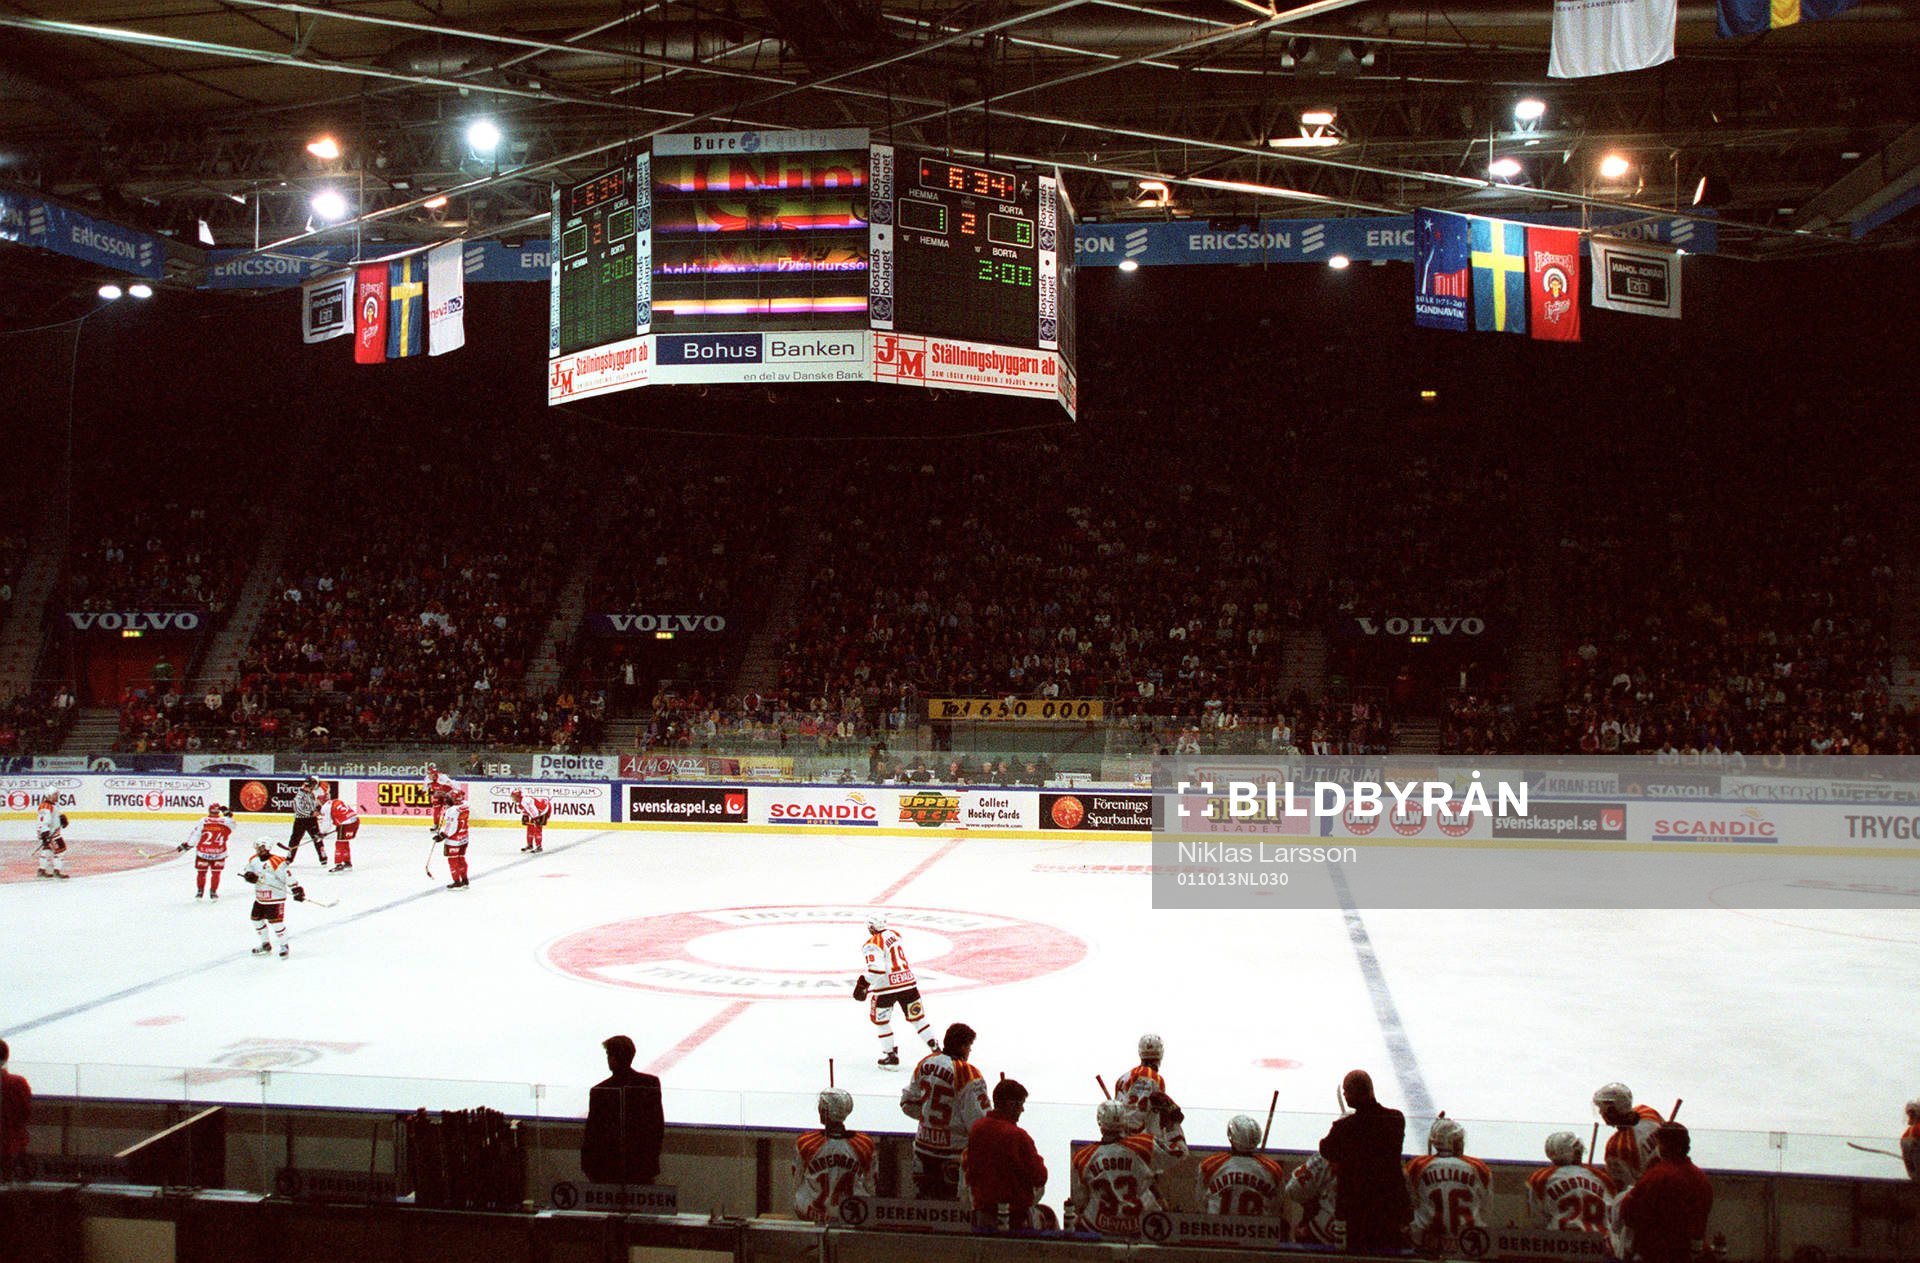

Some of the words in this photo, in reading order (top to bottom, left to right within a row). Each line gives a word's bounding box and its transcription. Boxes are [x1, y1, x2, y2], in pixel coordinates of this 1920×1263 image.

[693, 136, 736, 151] Bure
[871, 151, 881, 198] Bostads
[881, 153, 891, 199] bolaget
[908, 187, 939, 201] HEMMA
[998, 204, 1024, 217] BORTA
[961, 212, 976, 234] 2
[71, 225, 136, 259] ERICSSON
[1016, 222, 1030, 244] 0
[1188, 232, 1291, 250] ERICSSON
[1366, 229, 1415, 247] ERIC
[919, 235, 950, 250] HEMMA
[1074, 235, 1115, 253] SON
[520, 252, 551, 268] ERI
[992, 247, 1018, 260] BORTA
[214, 258, 301, 276] ERICSSON
[871, 247, 881, 296] Bostads
[881, 249, 891, 296] bolaget
[978, 259, 1032, 287] 2:00
[638, 341, 648, 362] ab
[683, 342, 757, 359] Bohus
[771, 341, 855, 357] Banken
[877, 337, 926, 378] JM
[931, 341, 1039, 376] Ställningsbyggarn
[1041, 356, 1056, 377] ab
[743, 373, 757, 381] en
[759, 371, 775, 381] del
[776, 372, 791, 381] av
[792, 371, 834, 381] Danske
[836, 370, 864, 380] Bank
[66, 611, 199, 631] VOLVO
[606, 614, 726, 632] VOLVO
[1354, 616, 1486, 635] VOLVO
[979, 701, 1028, 718] 650
[1042, 702, 1090, 719] 000
[300, 762, 316, 776] Är
[318, 763, 338, 776] du
[343, 763, 365, 776] rätt
[540, 756, 604, 770] Deloitte
[623, 757, 703, 775] ALMONDY
[1291, 767, 1382, 783] FUTURUM
[31, 792, 77, 807] HASA
[106, 793, 145, 807] TRYGG
[164, 795, 205, 808] HANSA
[1727, 783, 1828, 801] ROCKFORD
[552, 802, 596, 816] HANSA
[631, 799, 723, 817] svenskaspel.se
[899, 795, 960, 808] UPPER
[978, 797, 1009, 809] Collect
[1092, 797, 1149, 814] Förenings
[379, 807, 433, 816] BLADE
[770, 803, 877, 820] SCANDIC
[967, 809, 996, 822] Hockey
[997, 809, 1021, 820] Cards
[1086, 812, 1153, 828] Sparbanken
[1209, 824, 1283, 833] BLADET
[1495, 813, 1598, 834] svenskaspel.se
[1654, 818, 1776, 836] SCANDIC
[201, 830, 225, 847] 24
[889, 944, 910, 973] 19
[585, 1190, 676, 1207] BERENDSEN
[875, 1205, 972, 1224] BERENDSEN
[1428, 1187, 1475, 1237] 16
[1180, 1221, 1280, 1240] BERENDSEN
[1498, 1236, 1603, 1255] BERENDSEN
